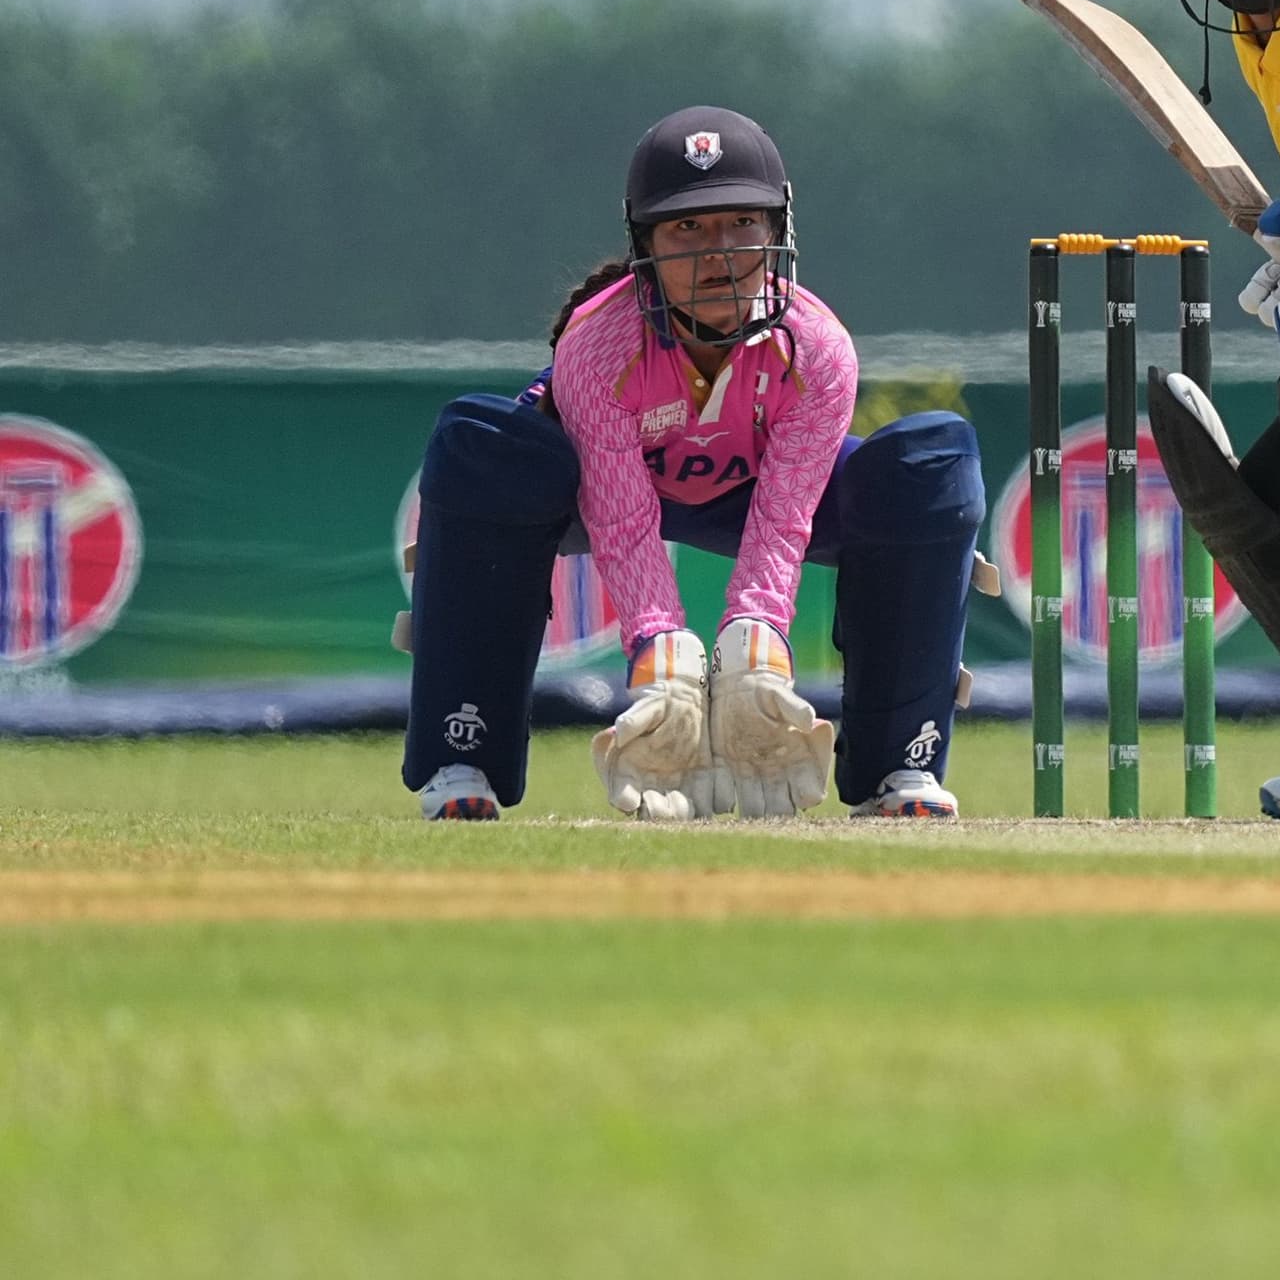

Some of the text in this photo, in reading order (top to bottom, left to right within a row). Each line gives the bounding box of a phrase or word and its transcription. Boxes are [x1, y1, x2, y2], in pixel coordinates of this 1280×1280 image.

[641, 410, 687, 432] PREMIER
[644, 447, 750, 485] APA
[450, 720, 480, 741] OT
[911, 737, 936, 759] OT
